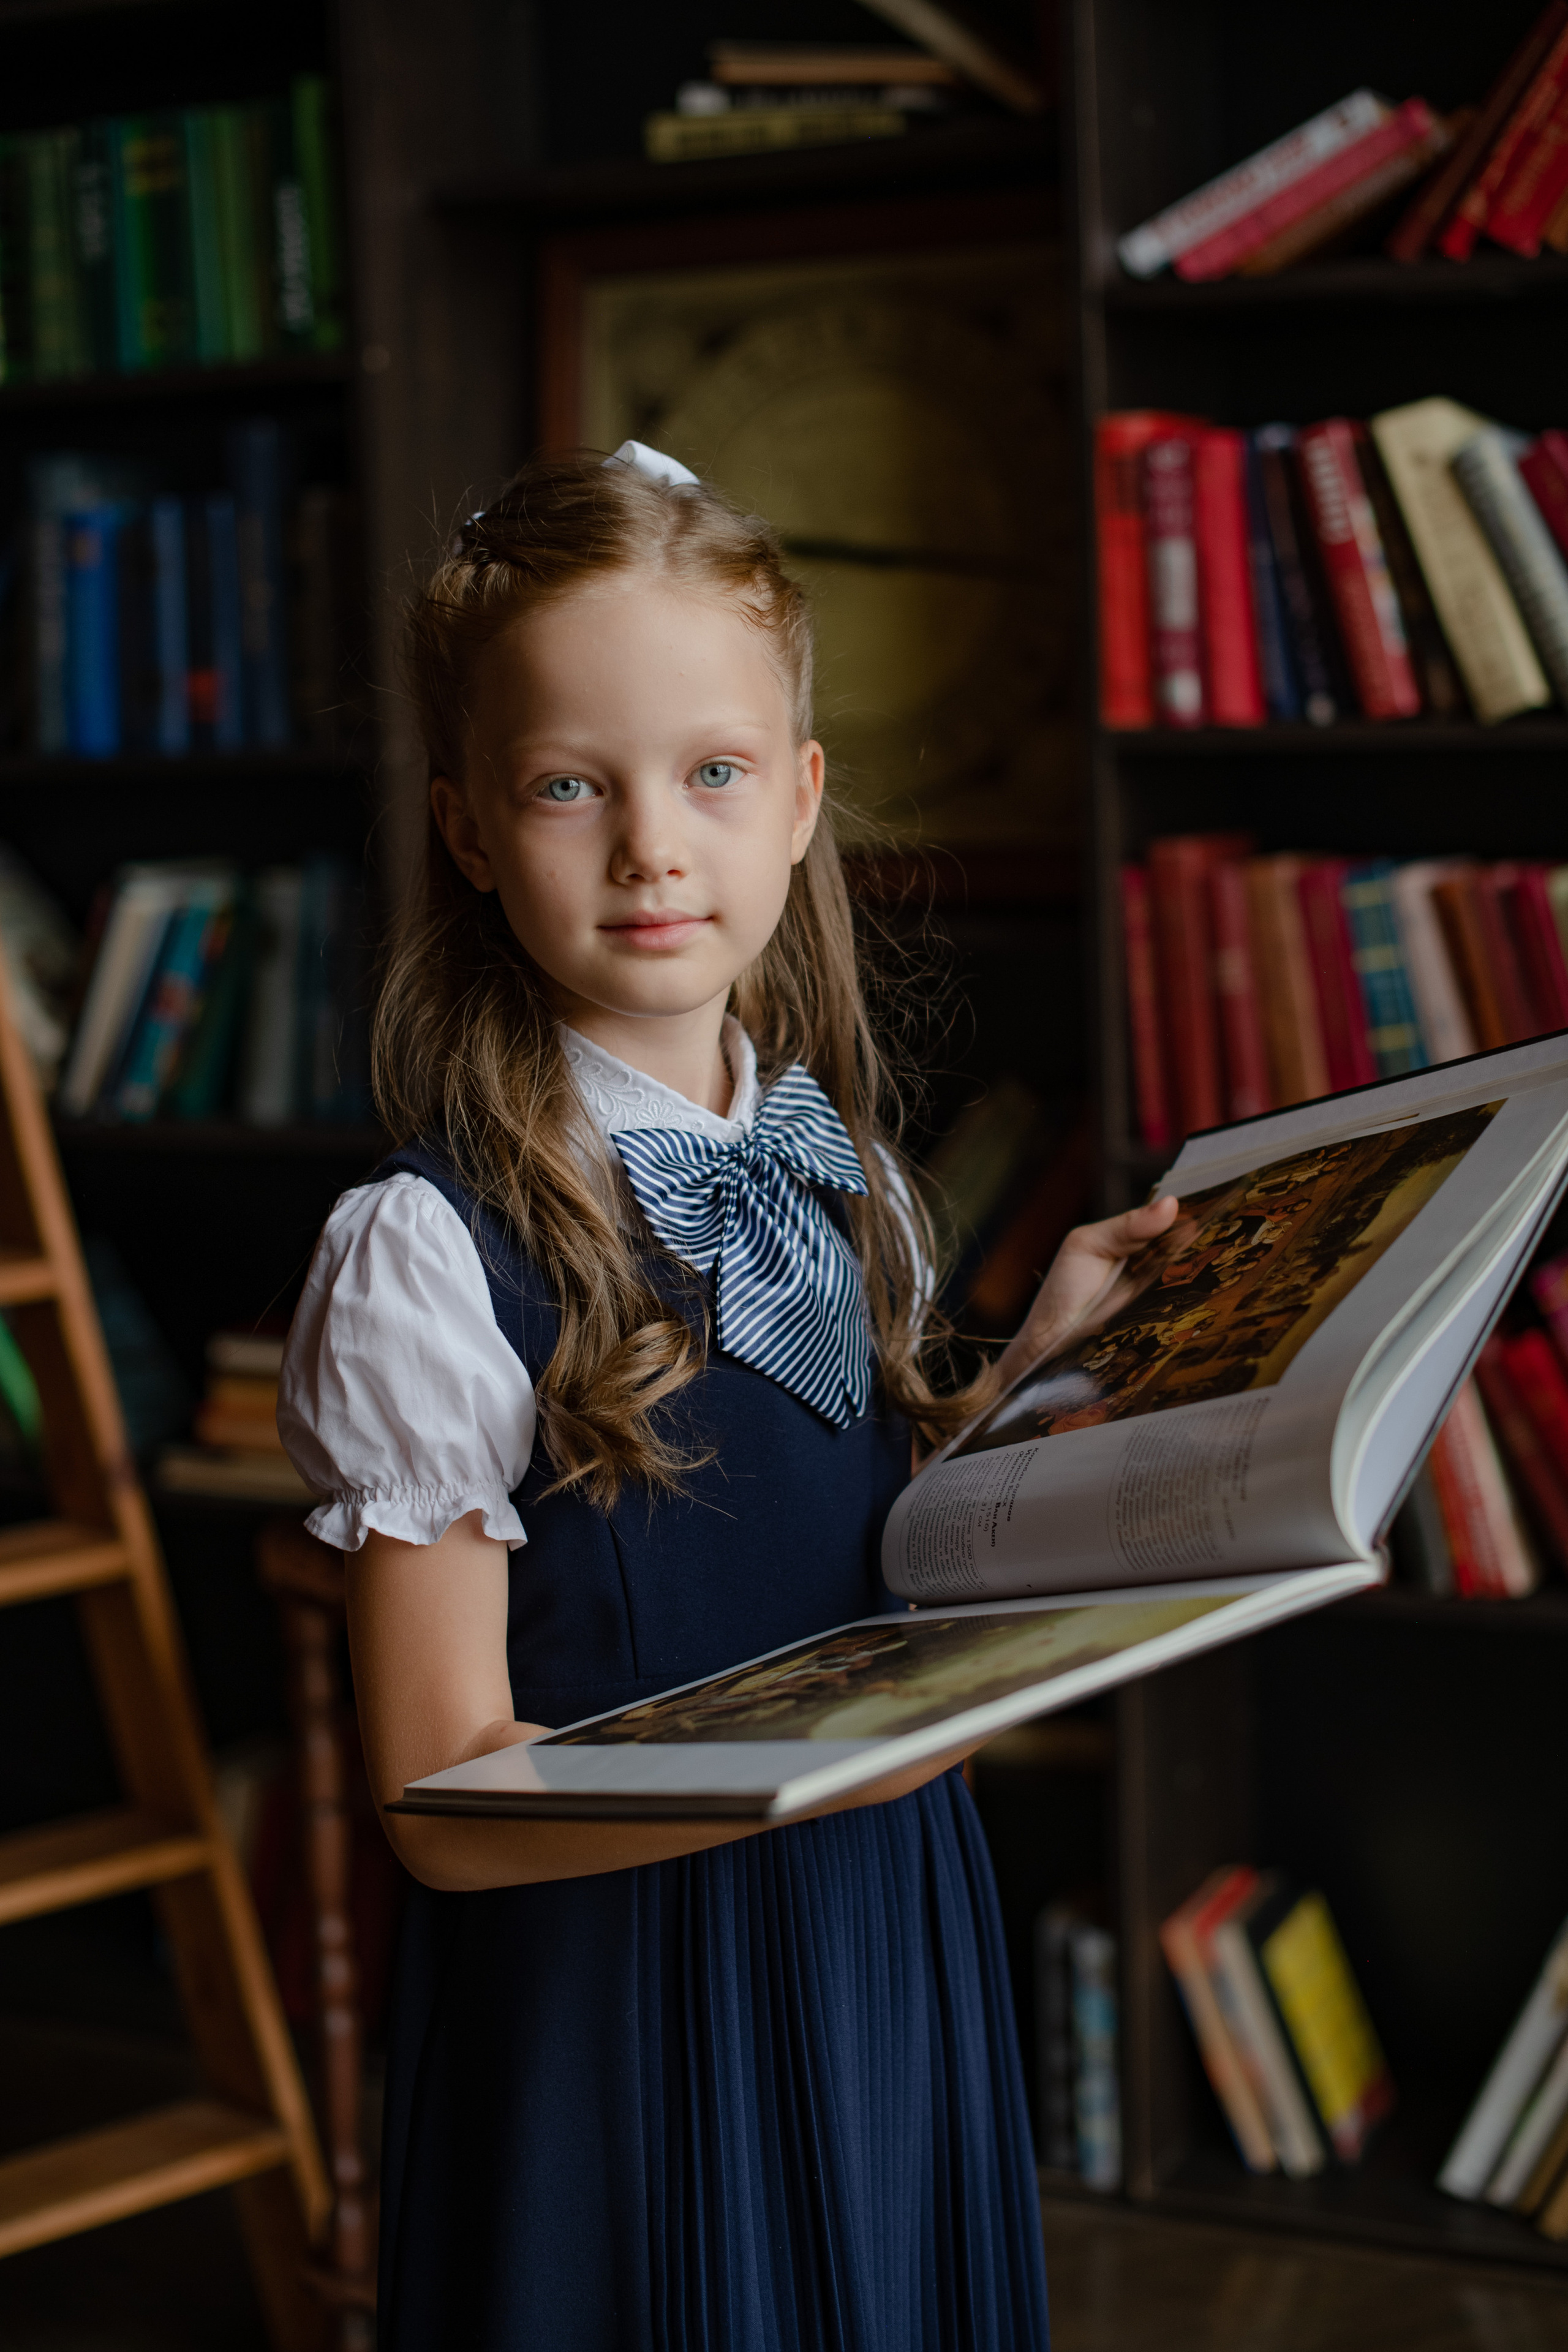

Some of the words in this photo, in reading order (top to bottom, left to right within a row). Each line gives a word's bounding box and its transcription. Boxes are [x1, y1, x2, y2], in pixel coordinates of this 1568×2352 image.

[1018, 1447, 1039, 1481] Корабль
[953, 1494, 963, 1519] задался
[1007, 1483, 1020, 1522] дураков
[939, 1504, 949, 1548] духовенства
[977, 1515, 982, 1527] см
[940, 1559, 951, 1583] общее
[946, 1559, 954, 1579] всего
[950, 1548, 962, 1581] высмеять
[970, 1563, 978, 1579] года
